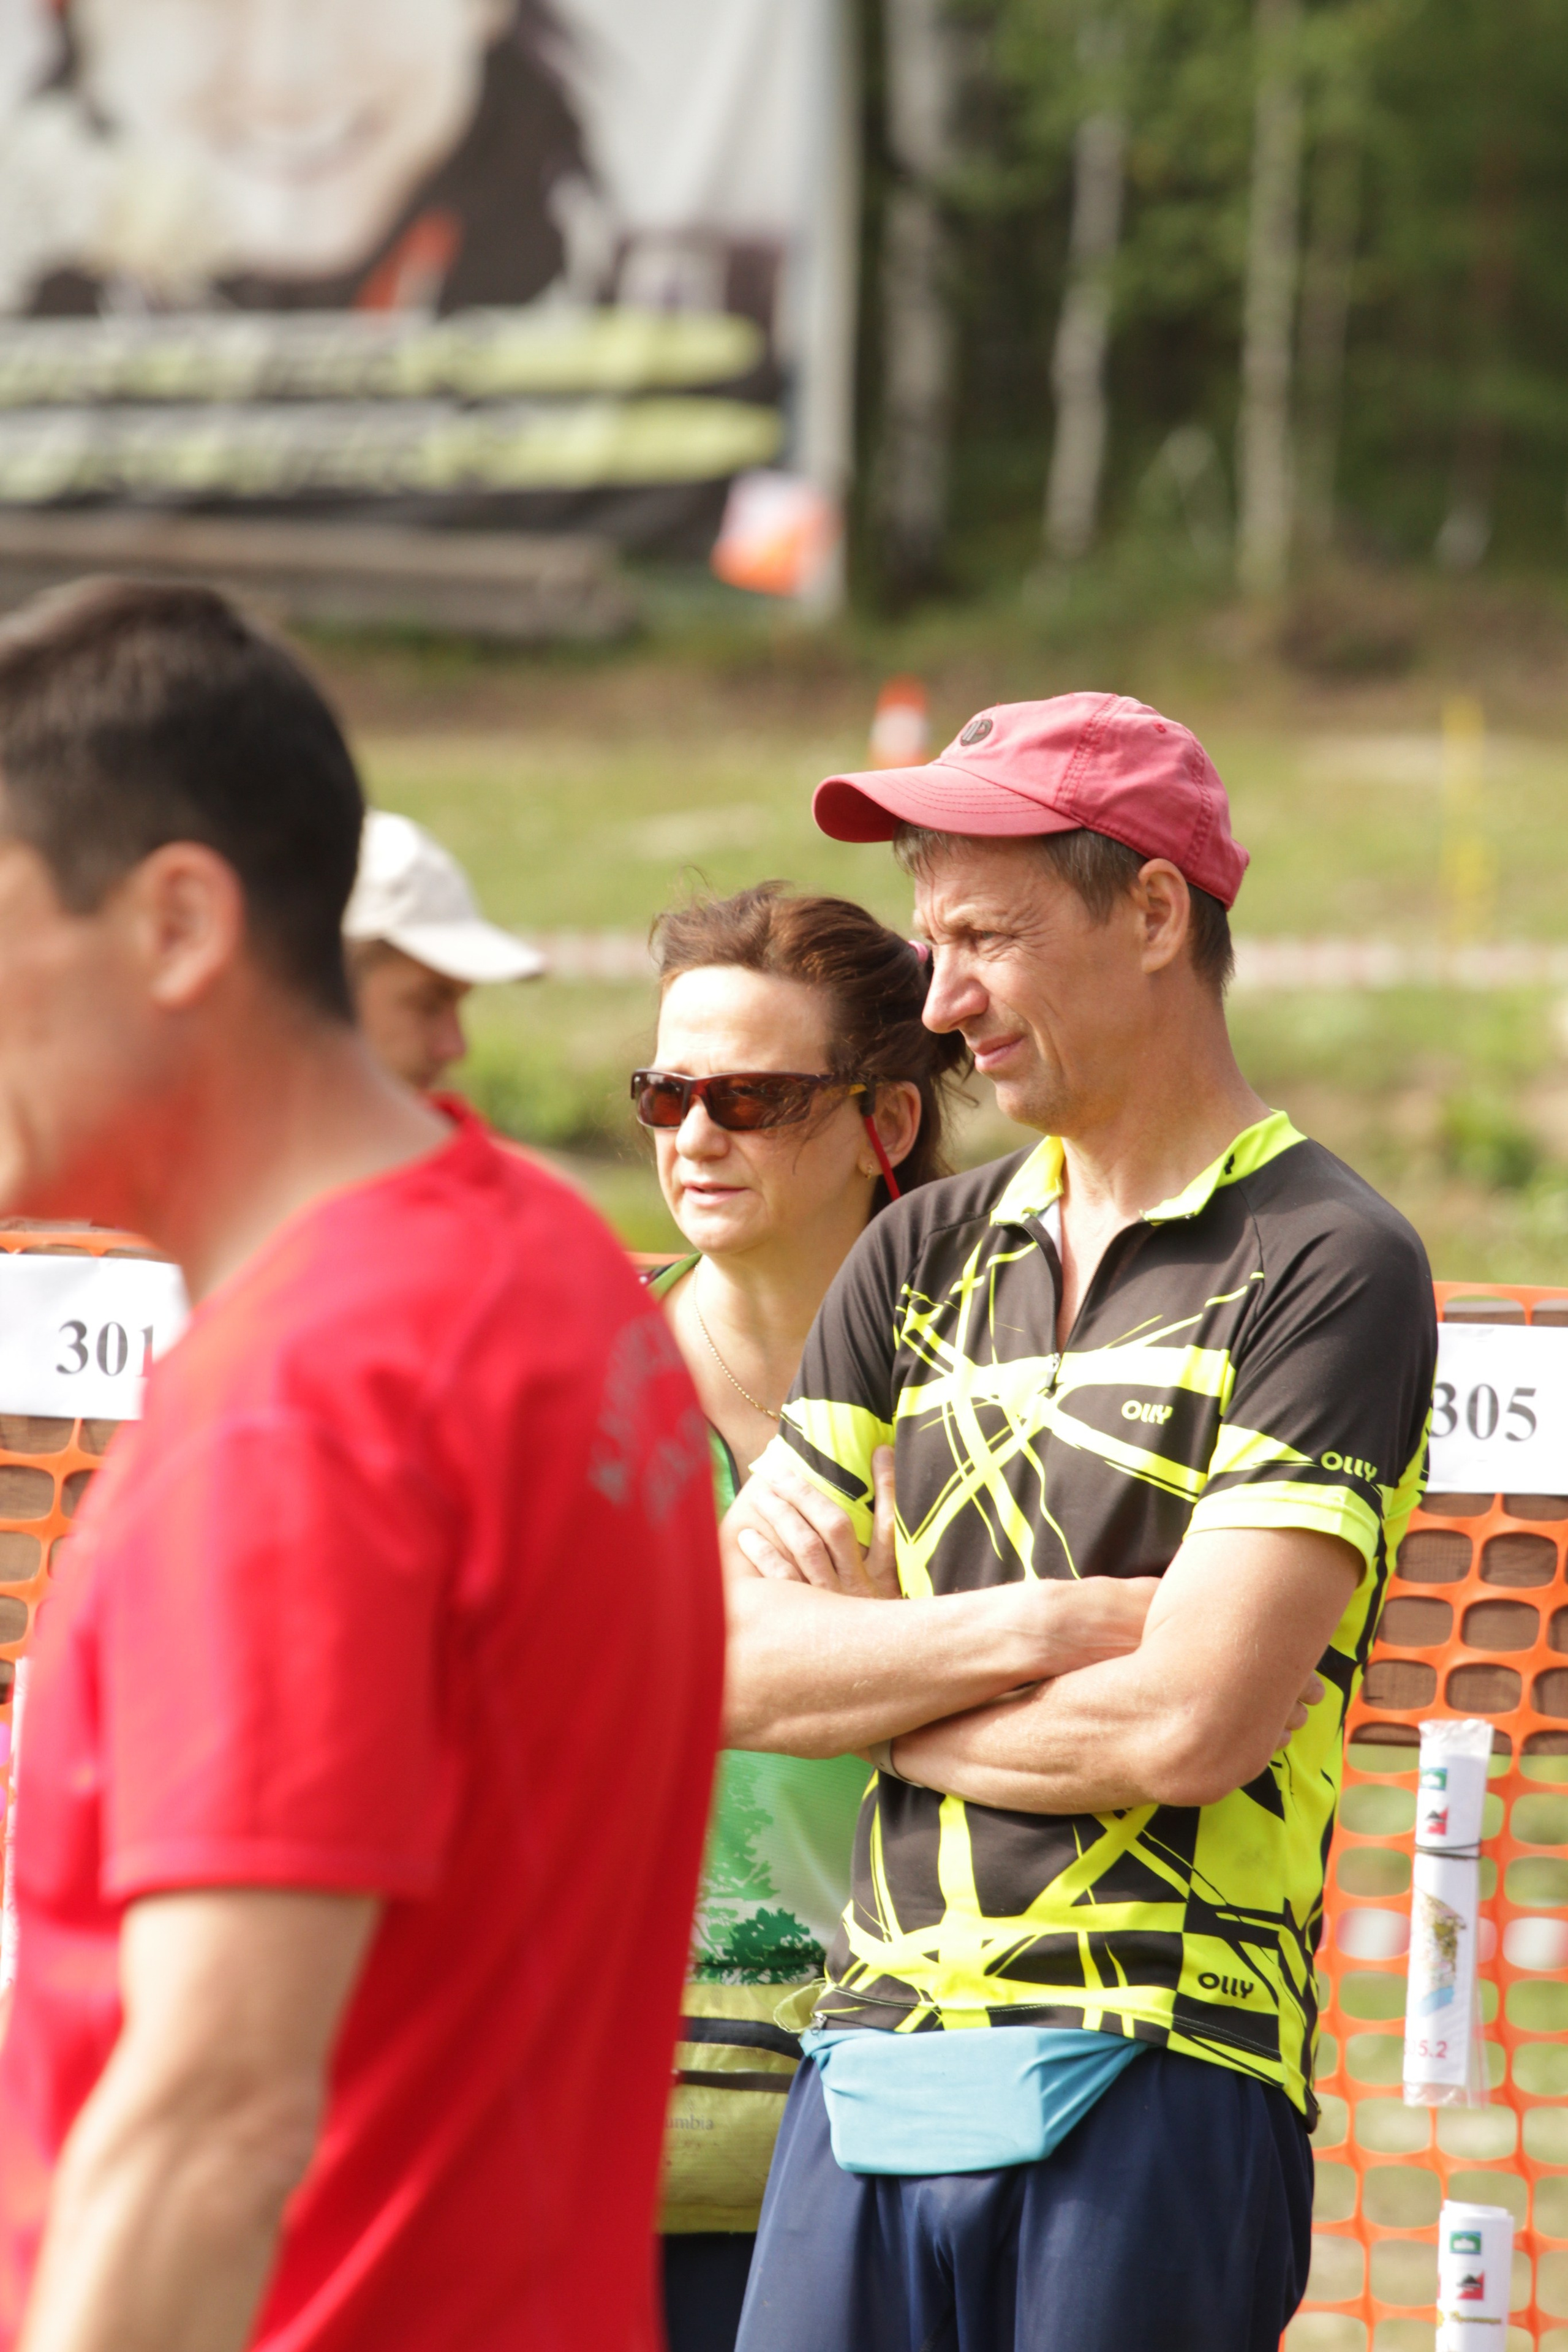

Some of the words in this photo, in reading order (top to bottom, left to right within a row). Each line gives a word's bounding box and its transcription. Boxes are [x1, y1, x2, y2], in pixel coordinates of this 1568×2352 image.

[1121, 1399, 1174, 1425] OLLY
[1431, 1382, 1537, 1441] 305
[1321, 1451, 1378, 1482] OLLY
[1197, 1972, 1254, 1999] OLLY
